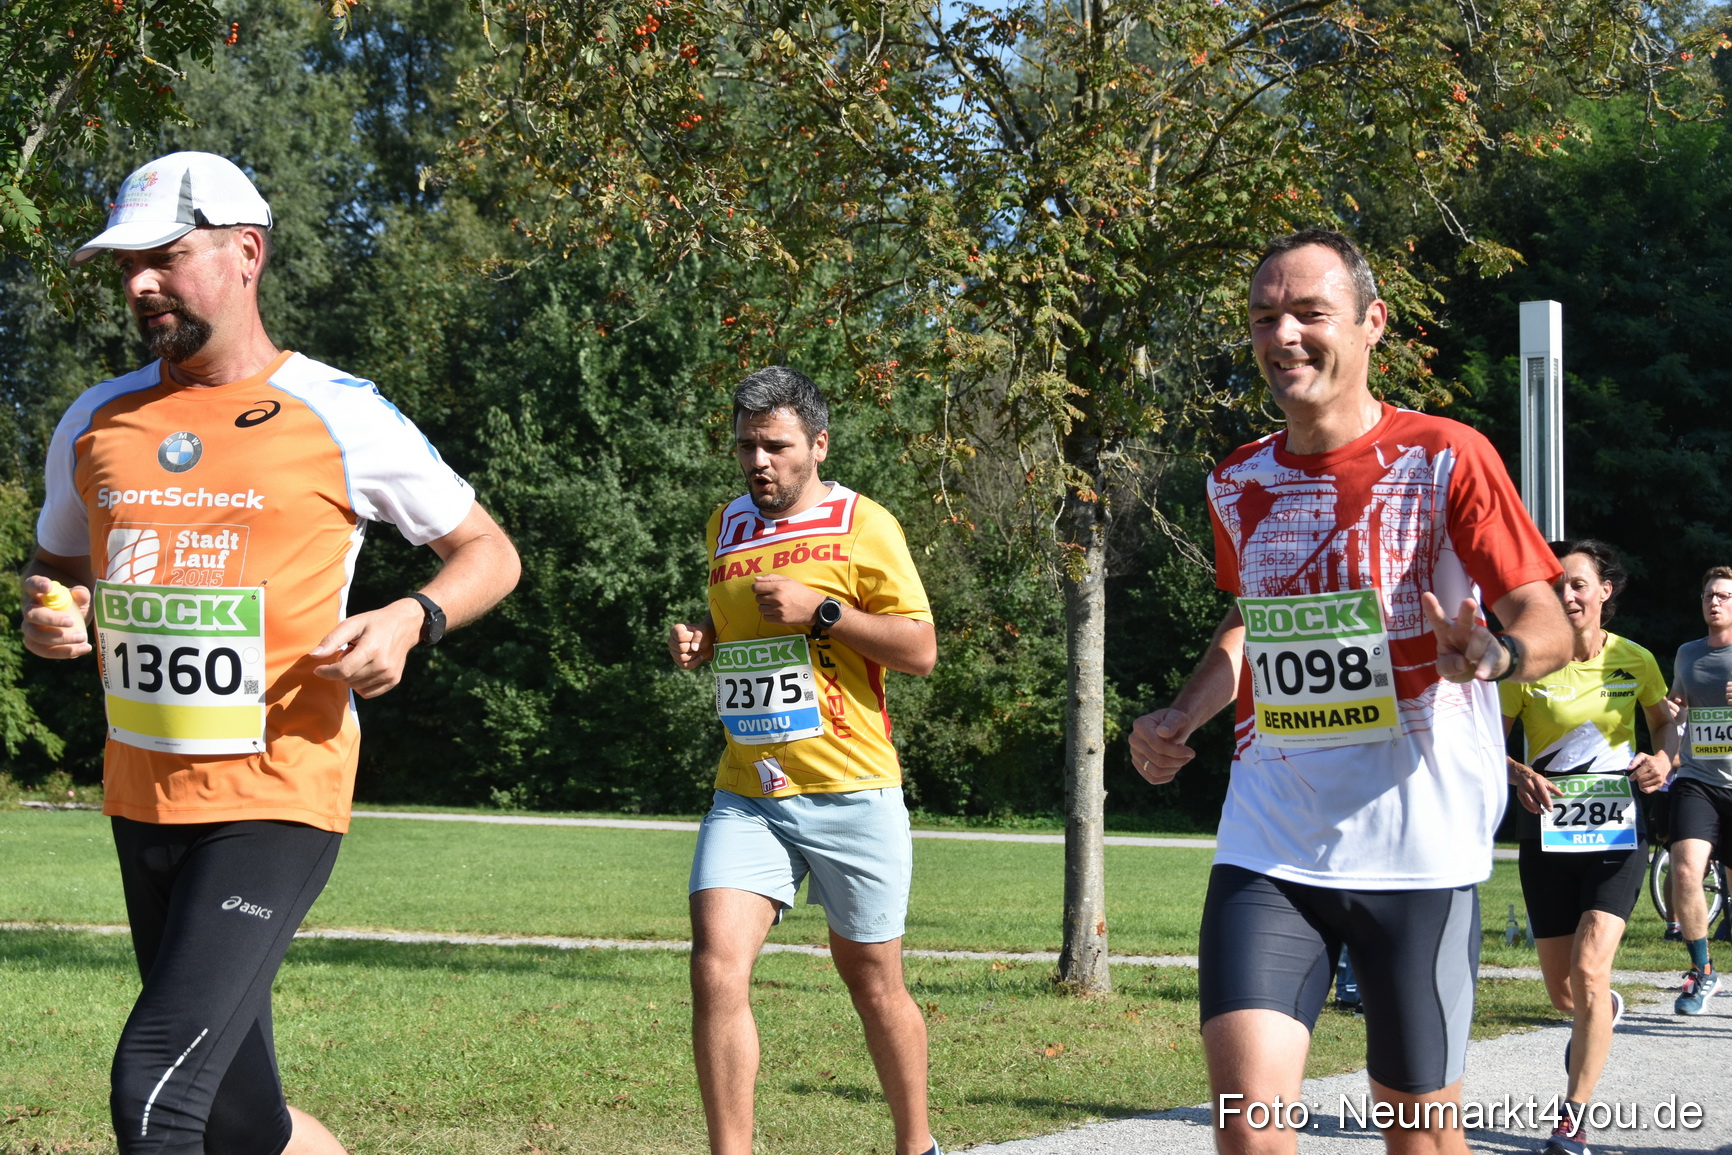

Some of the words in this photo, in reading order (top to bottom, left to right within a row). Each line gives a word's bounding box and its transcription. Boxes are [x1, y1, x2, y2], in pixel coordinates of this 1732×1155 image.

[164, 432, 200, 446] BMW
[98, 487, 265, 510] SportScheck
[175, 529, 239, 550] Stadt
[1261, 531, 1296, 543] 52.01
[173, 549, 231, 569] Lauf
[709, 556, 763, 587] MAX
[772, 542, 849, 569] BÖGL
[1259, 552, 1295, 566] 26.22
[170, 568, 224, 588] 2015
[103, 589, 243, 629] BOCK
[1248, 600, 1364, 636] BOCK
[718, 641, 799, 668] BOCK
[1373, 648, 1380, 656] C
[114, 642, 242, 696] 1360
[1256, 647, 1372, 695] 1098
[725, 673, 802, 709] 2375
[1600, 690, 1635, 698] Runners
[738, 716, 791, 733] OVIDIU
[1264, 705, 1380, 729] BERNHARD
[1553, 802, 1624, 826] 2284
[1573, 834, 1606, 844] RITA
[239, 902, 273, 920] asics
